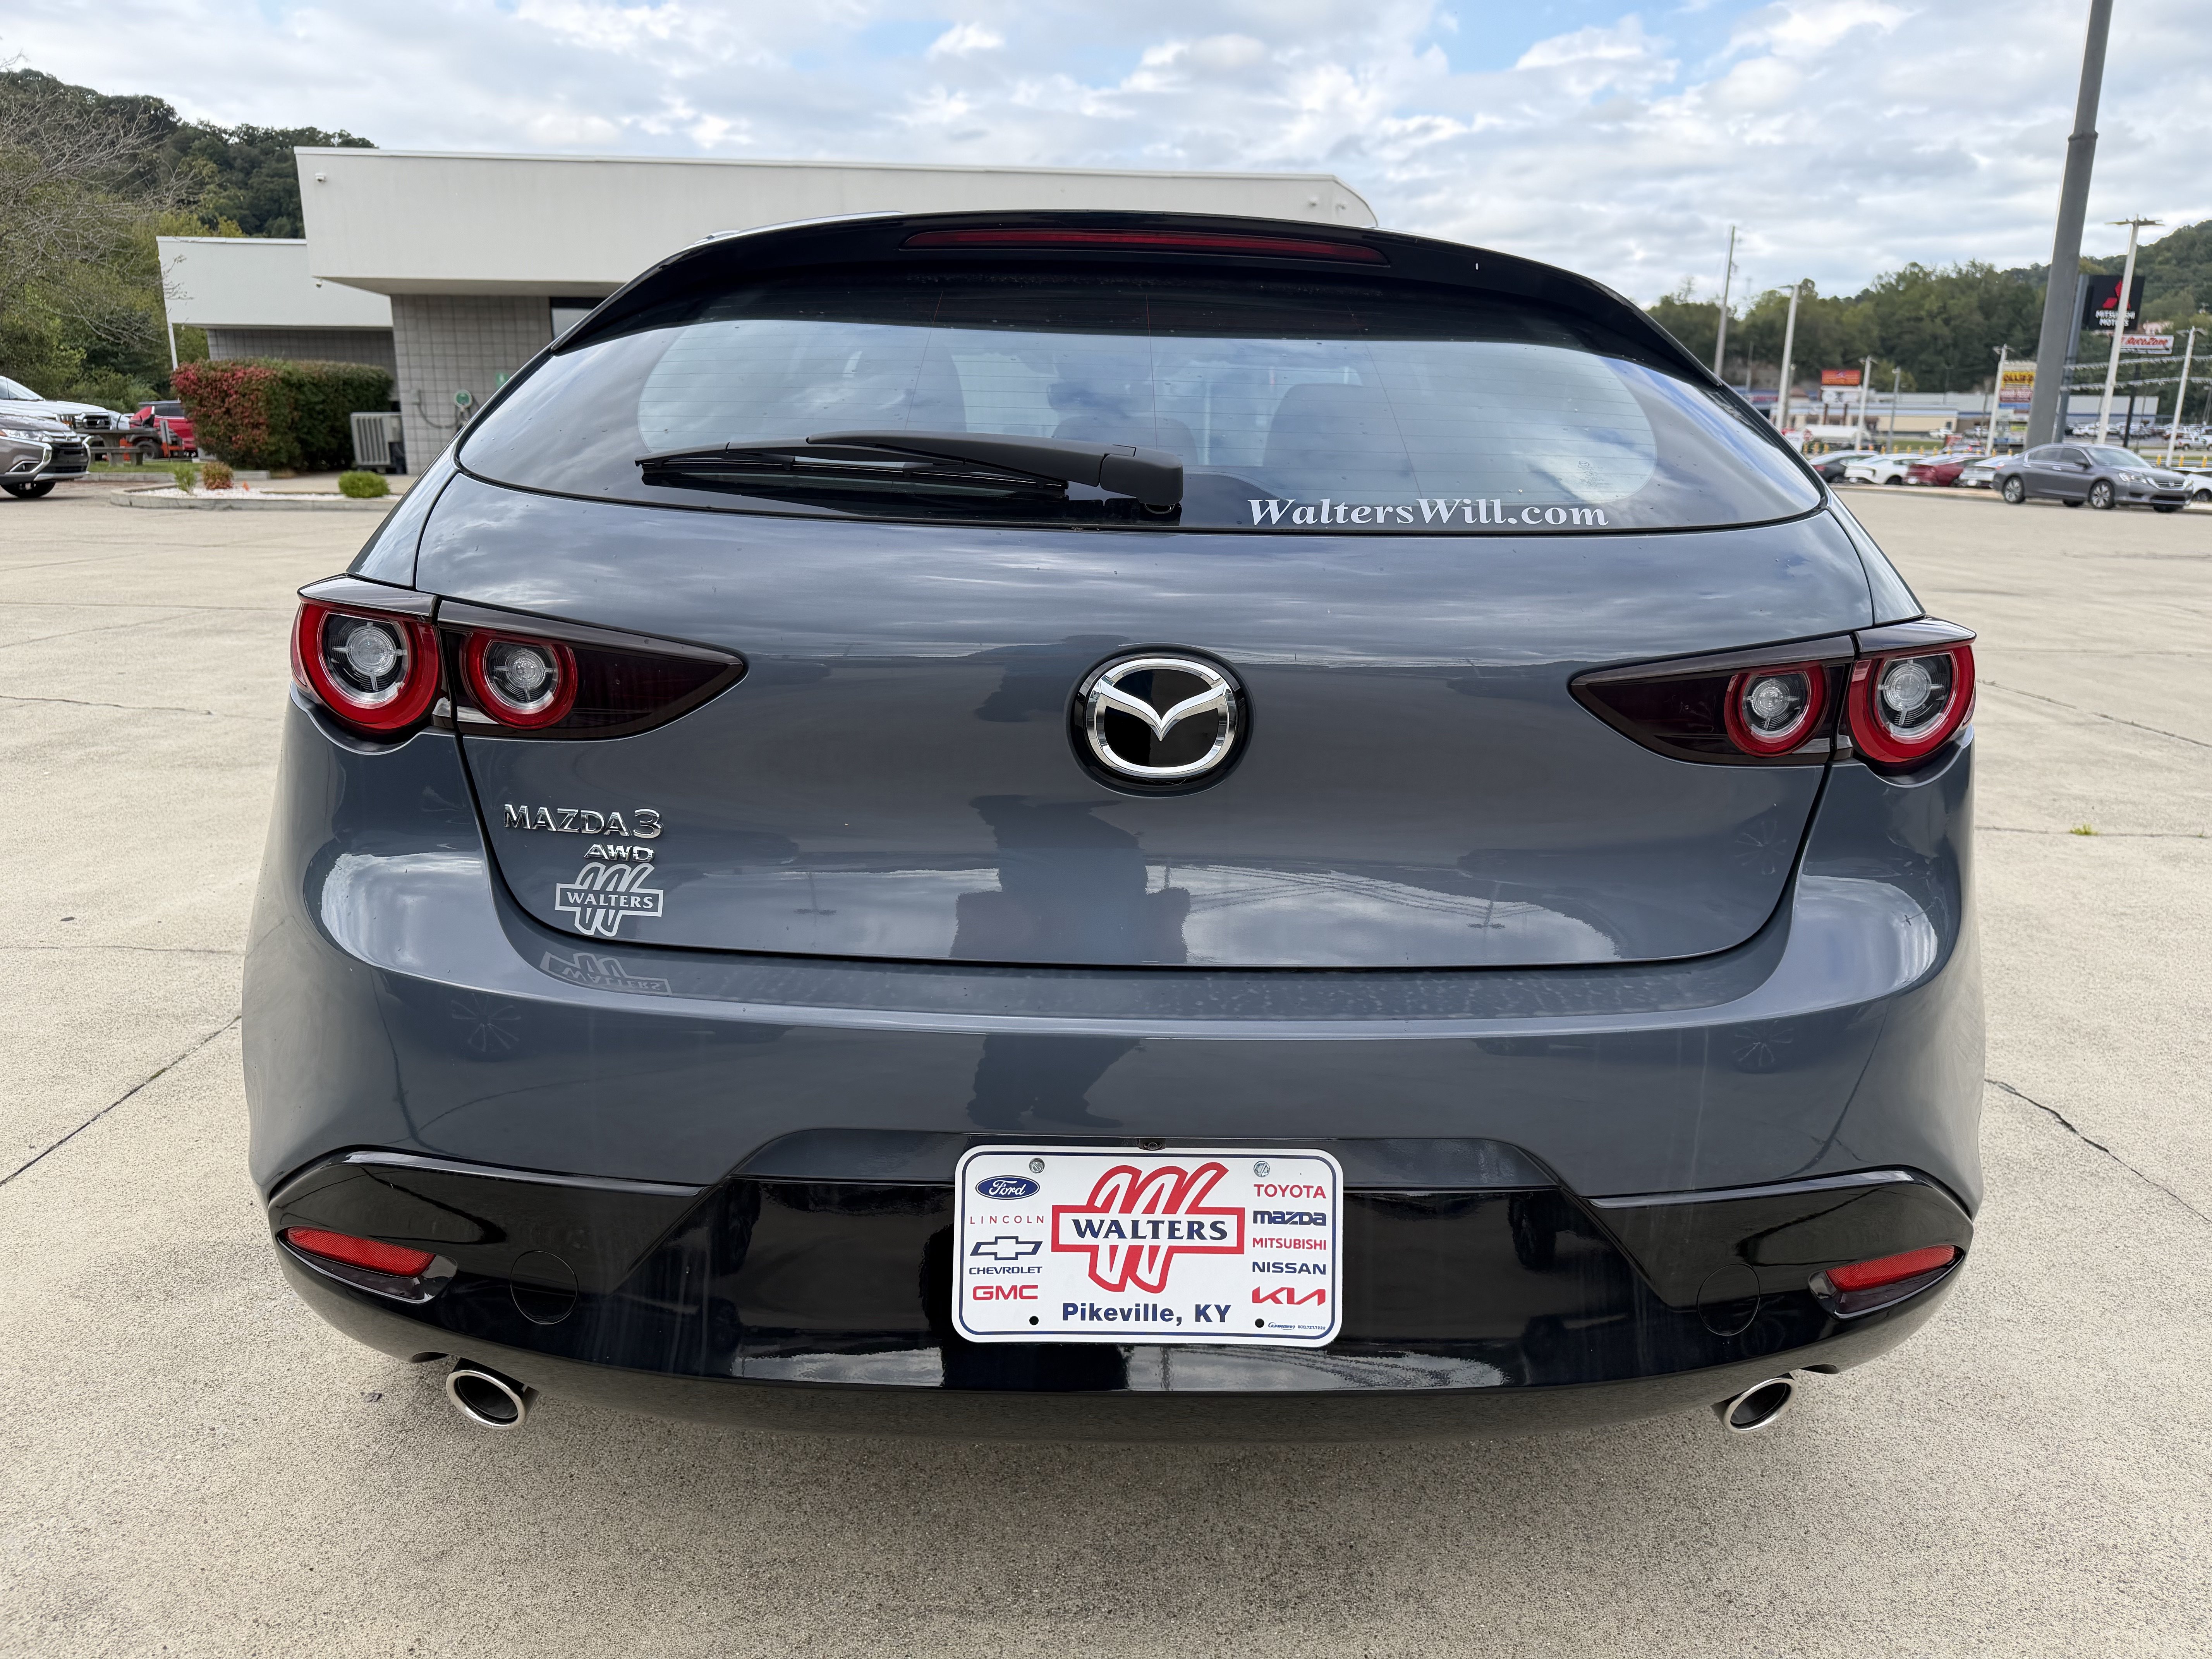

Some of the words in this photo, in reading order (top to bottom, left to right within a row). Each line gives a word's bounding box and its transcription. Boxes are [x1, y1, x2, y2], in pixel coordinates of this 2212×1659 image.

[2095, 310, 2135, 319] MITSUSHI
[1247, 498, 1609, 526] WaltersWill.com
[584, 843, 657, 863] AWD
[567, 891, 654, 909] WALTERS
[989, 1180, 1027, 1195] Ford
[1254, 1184, 1326, 1199] TOYOTA
[1072, 1219, 1228, 1240] WALTERS
[1253, 1238, 1326, 1250] MITSUBISHI
[969, 1266, 1043, 1275] CHEVROLET
[1252, 1261, 1326, 1275] NISSAN
[972, 1285, 1038, 1300] GMC
[1252, 1286, 1326, 1305] KIA
[1062, 1302, 1182, 1326] Pikeville,
[1195, 1304, 1232, 1322] KY
